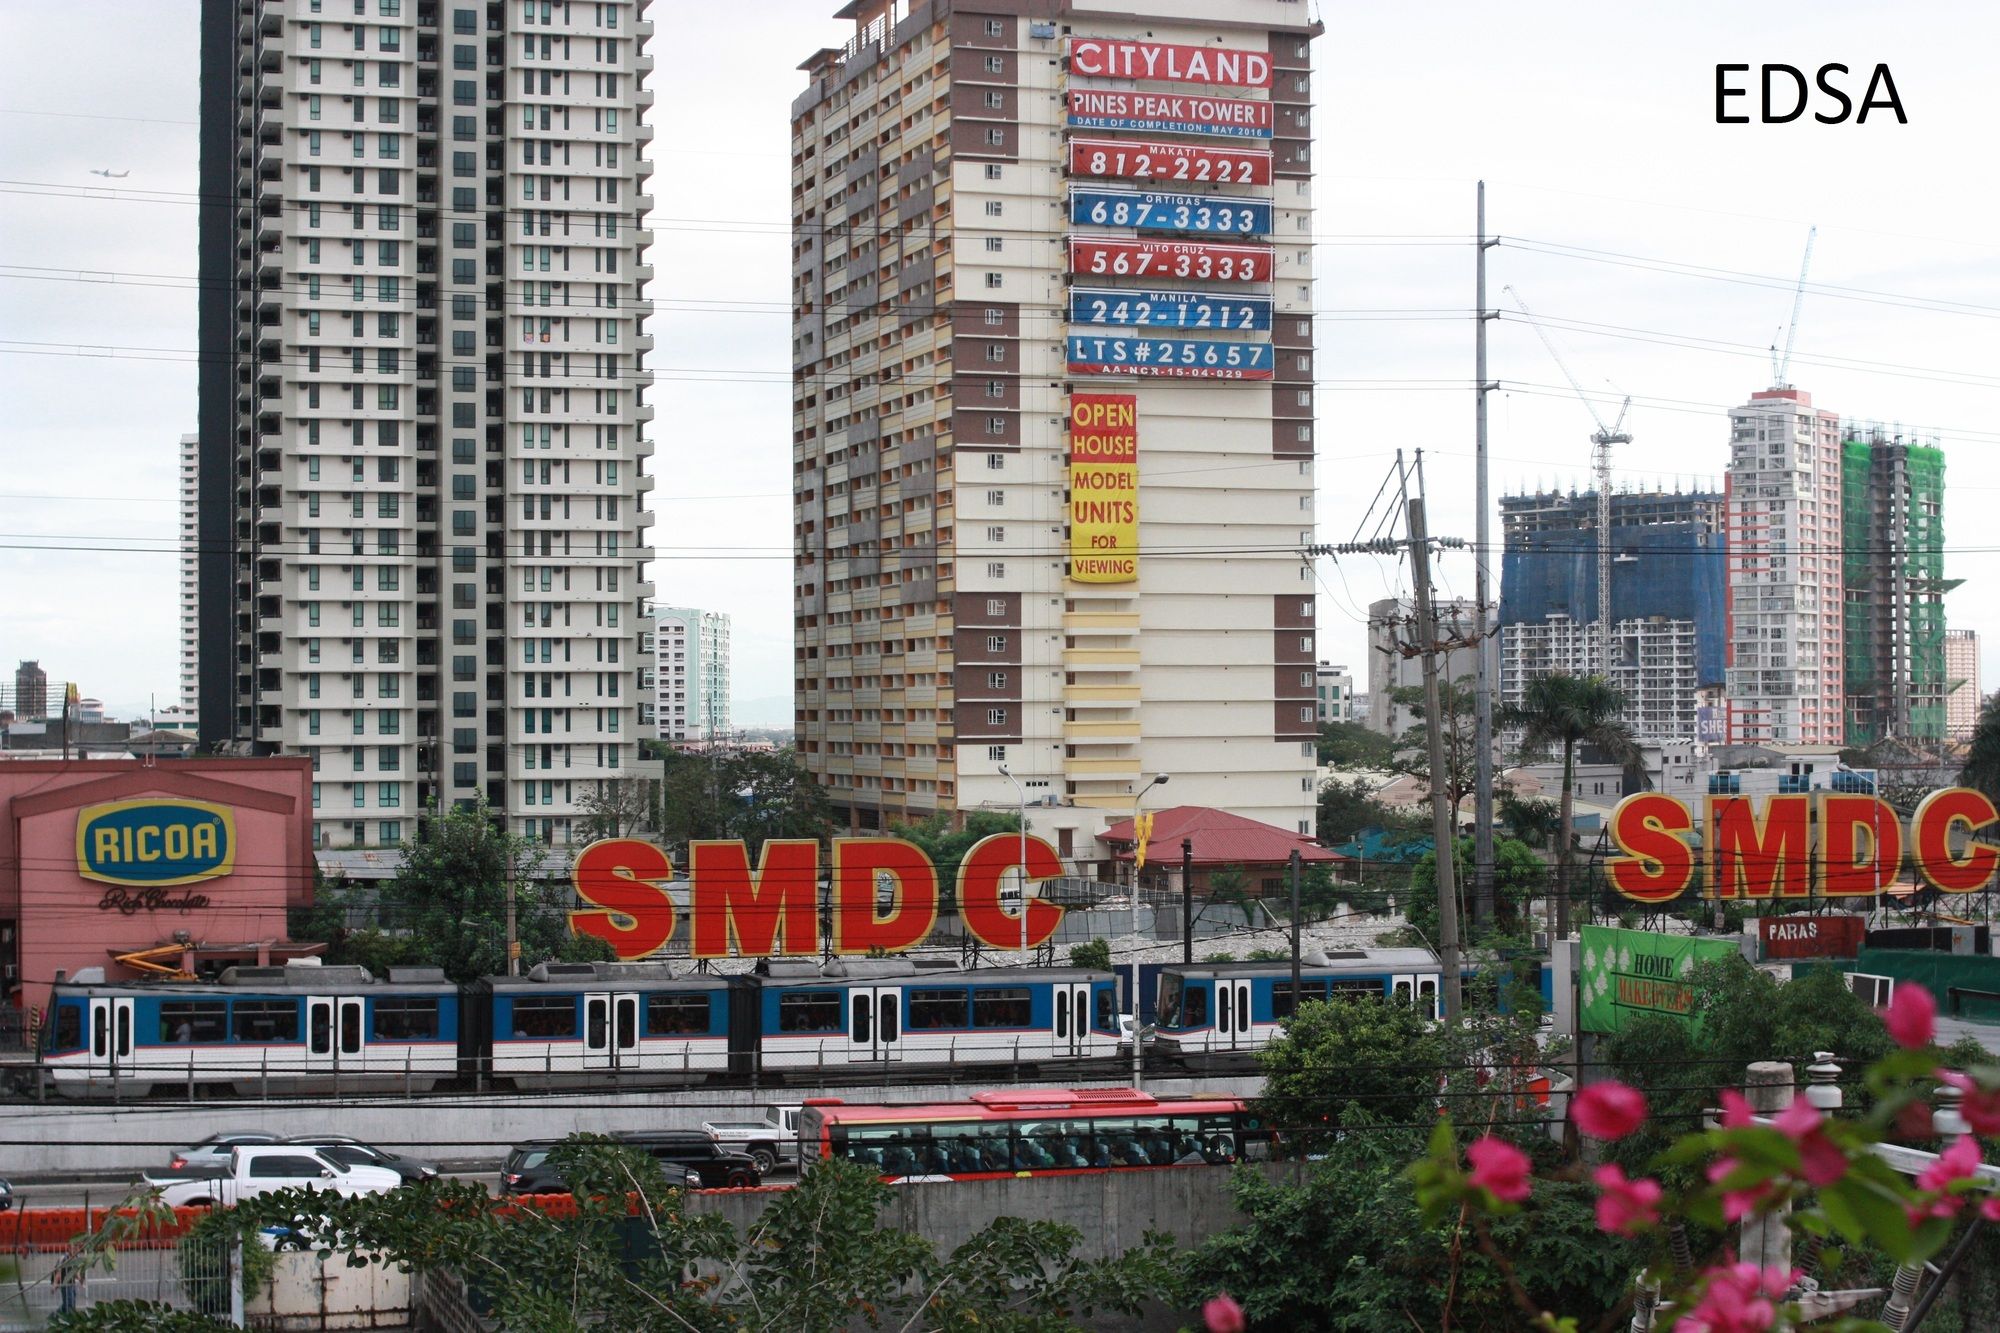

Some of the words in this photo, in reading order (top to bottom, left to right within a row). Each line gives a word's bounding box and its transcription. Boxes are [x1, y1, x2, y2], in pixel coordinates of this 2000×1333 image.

[1076, 43, 1268, 84] CITYLAND
[1074, 94, 1127, 114] PINES
[1134, 97, 1183, 118] PEAK
[1189, 101, 1255, 122] TOWER
[1261, 106, 1266, 124] I
[1077, 117, 1105, 126] DATE
[1110, 119, 1125, 127] OF
[1130, 120, 1207, 132] COMPLETION:
[1212, 126, 1233, 135] MAY
[1238, 127, 1262, 136] 2016
[1150, 146, 1196, 157] MAKATI
[1091, 152, 1253, 183] 812-2222
[1146, 195, 1200, 206] ORTIGAS
[1091, 202, 1254, 232] 687-3333
[1143, 244, 1169, 252] VITO
[1174, 245, 1204, 255] CRUZ
[1091, 251, 1254, 281] 567-3333
[1150, 294, 1197, 303] MANILA
[1091, 300, 1254, 328] 242-1212
[1073, 403, 1134, 427] OPEN
[1074, 436, 1134, 455] HOUSE
[1074, 472, 1134, 489] MODEL
[1075, 501, 1133, 524] UNITS
[1092, 536, 1117, 549] FOR
[1075, 560, 1134, 574] VIEWING
[95, 823, 217, 864] RICOA
[1604, 787, 2000, 903] SMDC
[99, 887, 143, 915] Rich
[568, 832, 1066, 961] SMDC
[1769, 922, 1818, 940] PARAS
[1635, 954, 1674, 978] HOME
